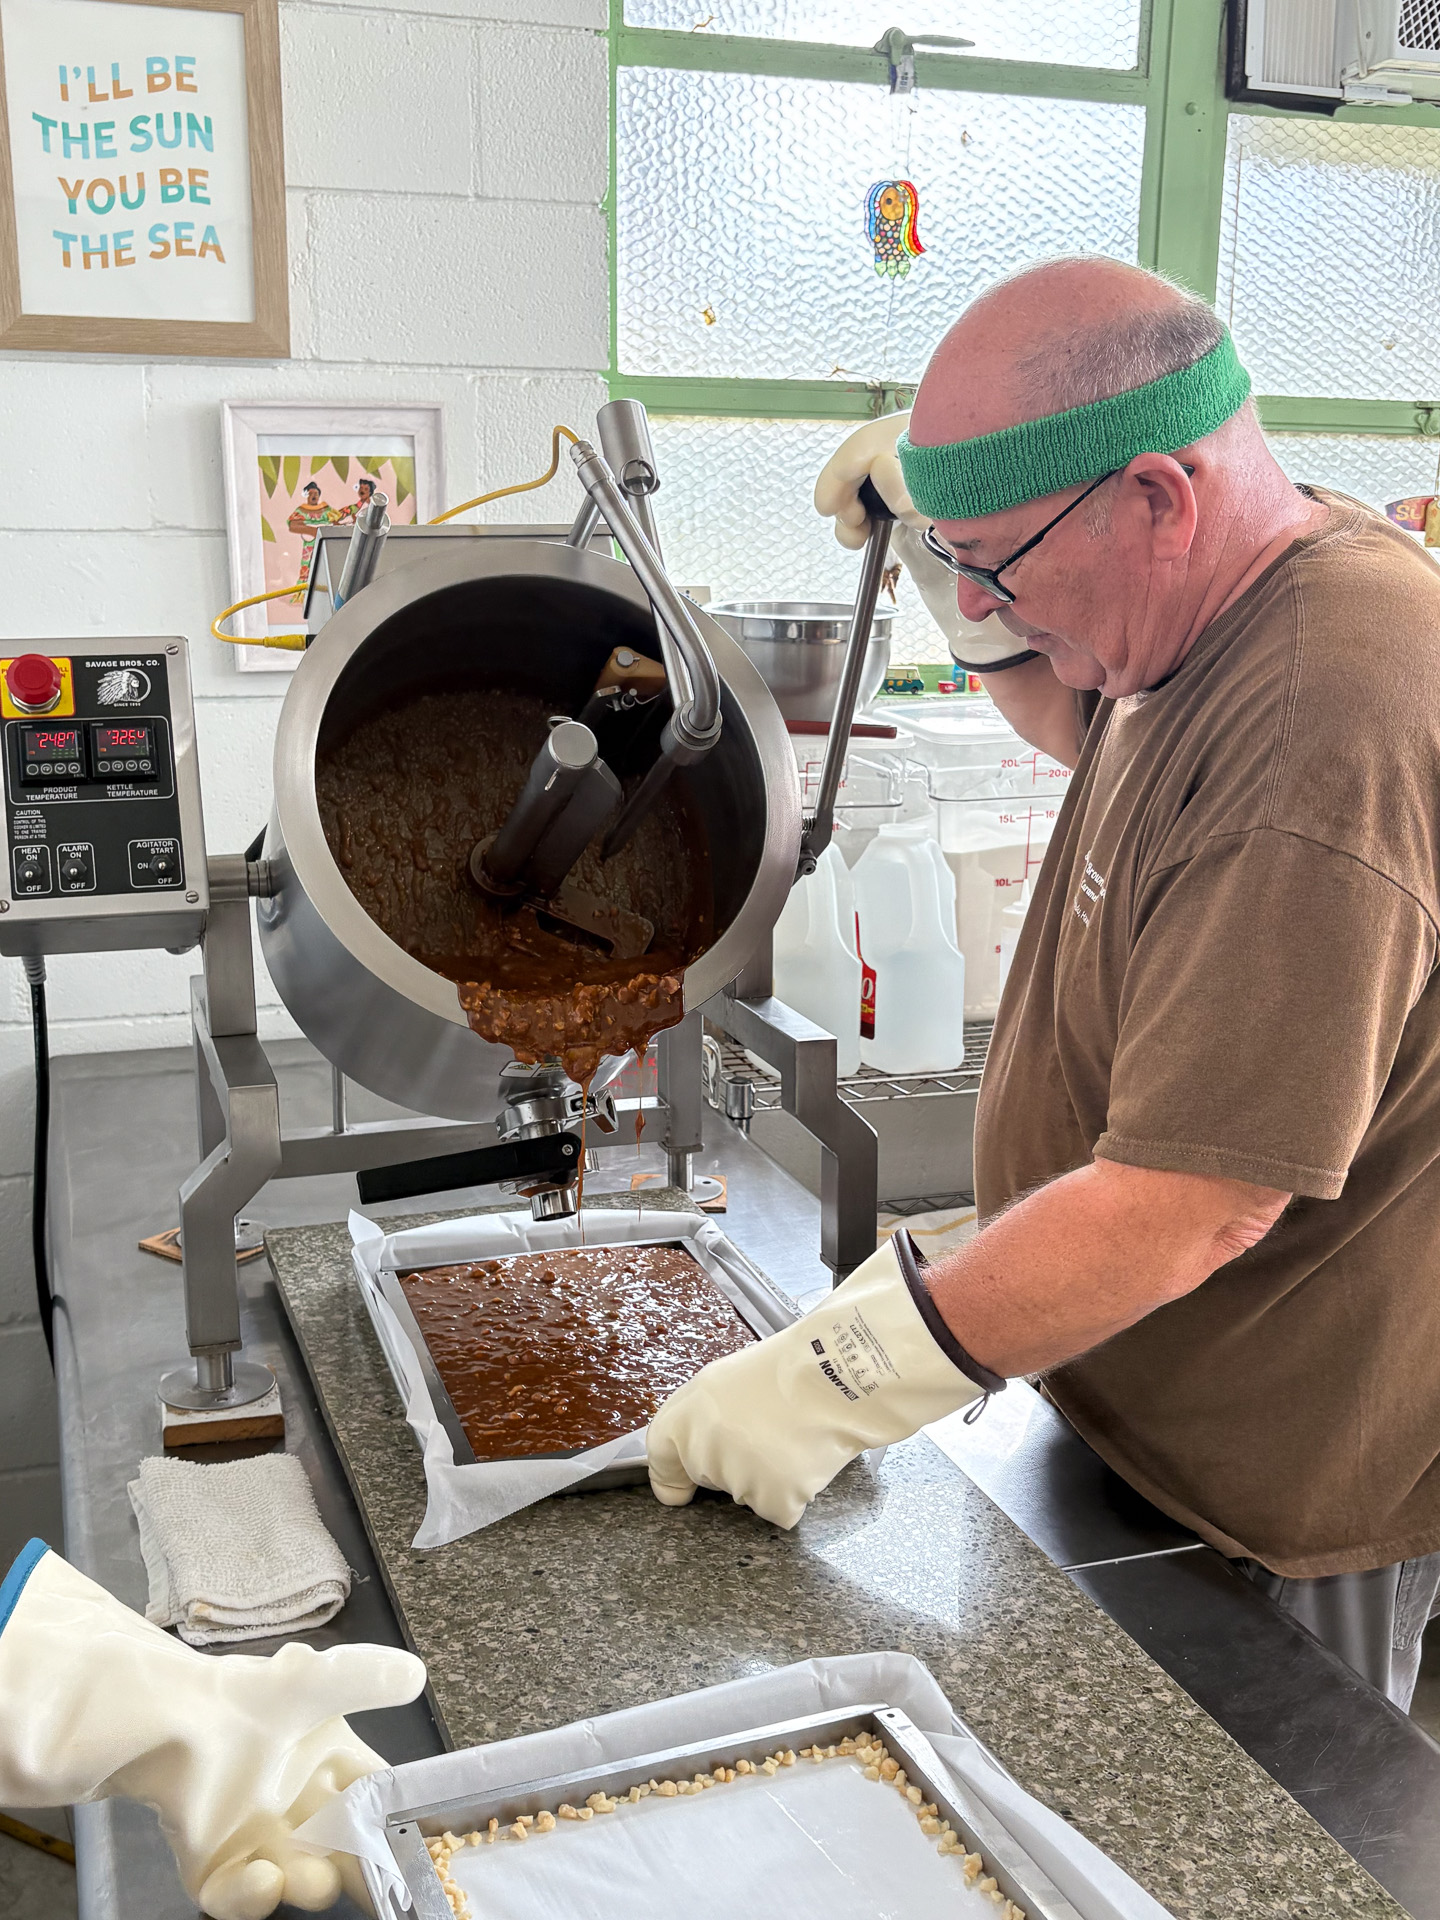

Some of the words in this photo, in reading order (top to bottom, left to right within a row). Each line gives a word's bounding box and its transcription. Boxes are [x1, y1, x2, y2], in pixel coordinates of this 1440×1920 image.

[146, 56, 198, 93] BE
[32, 111, 117, 159] THE
[129, 112, 214, 153] SUN
[58, 172, 146, 215] YOU
[159, 168, 211, 205] BE
[53, 229, 136, 270] THE
[148, 222, 226, 264] SEA
[1001, 759, 1020, 768] 20L
[26, 793, 78, 801] TEMPERATURE
[108, 789, 158, 797] TEMPERATURE
[999, 815, 1016, 823] 15L
[995, 878, 1011, 886] 10L
[819, 1360, 850, 1391] LANON
